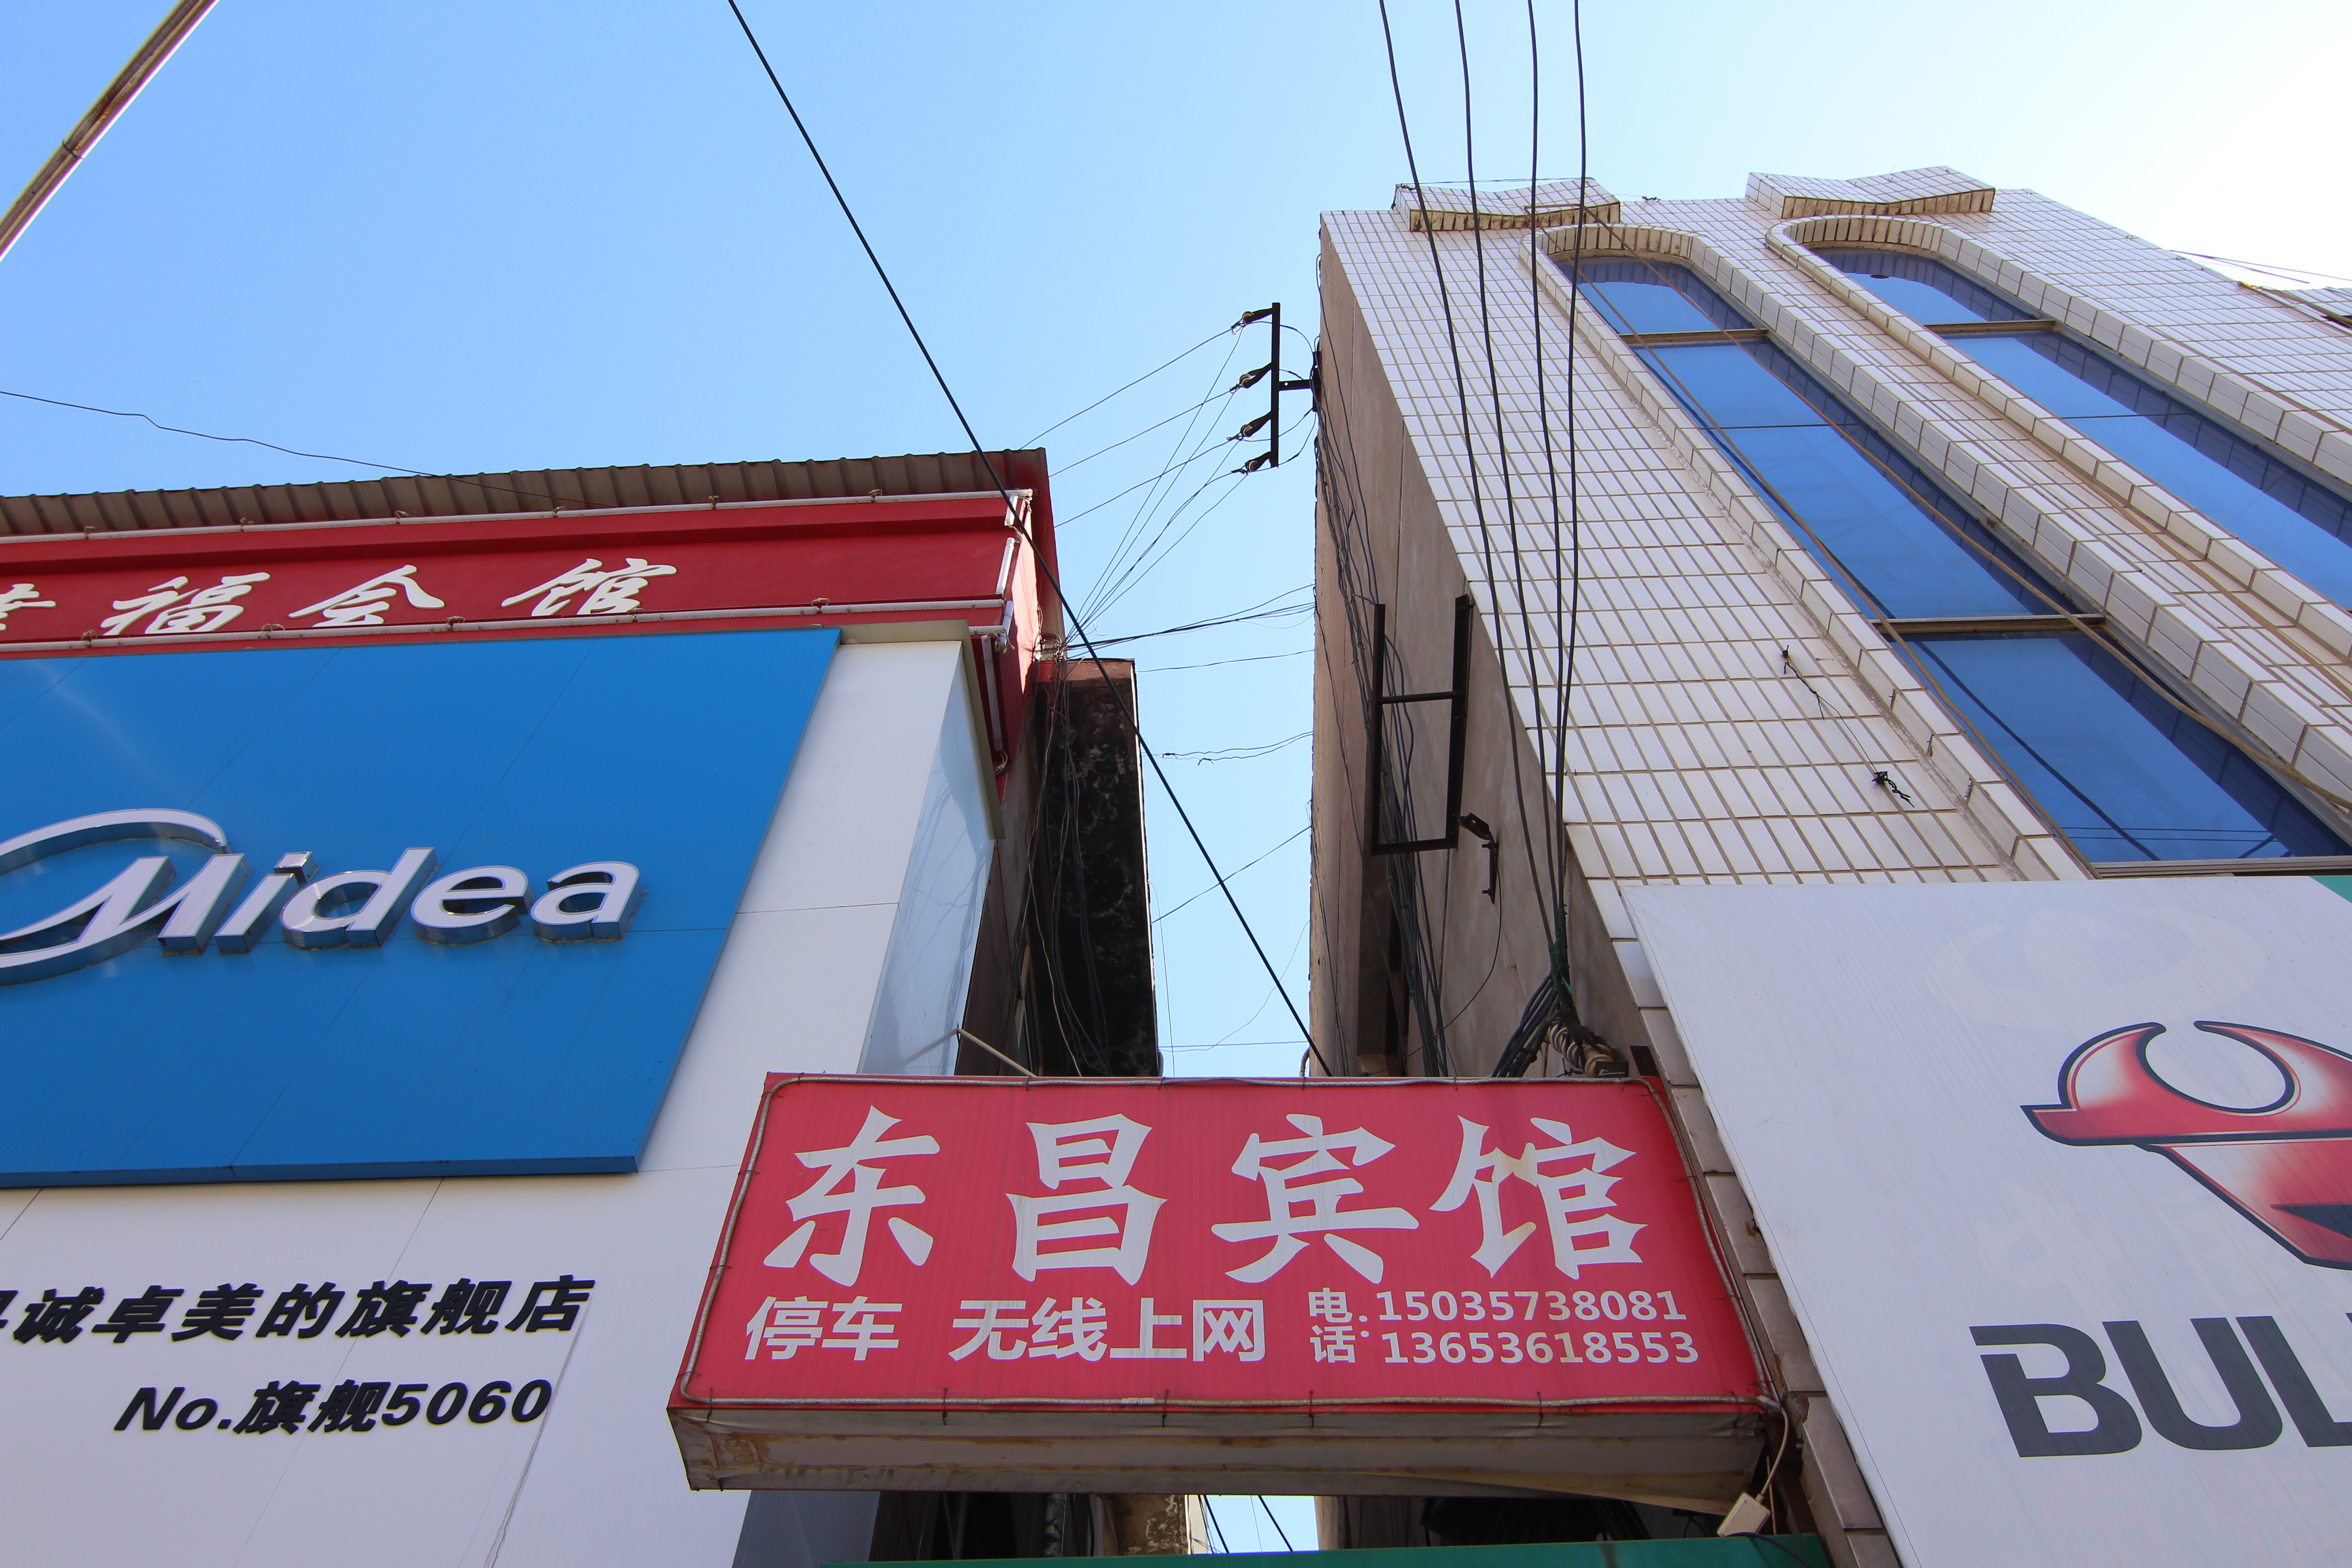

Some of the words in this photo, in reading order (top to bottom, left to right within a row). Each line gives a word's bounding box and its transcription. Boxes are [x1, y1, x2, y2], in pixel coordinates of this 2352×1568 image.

[0, 808, 641, 980] Midea
[764, 1105, 1650, 1287] 东昌宾馆
[0, 1274, 595, 1343] 诚卓美的旗舰店
[745, 1295, 903, 1361] 停车
[948, 1297, 1266, 1362] 无线上网
[1376, 1290, 1687, 1321] 15035738081
[1381, 1331, 1699, 1364] 13653618553
[1969, 1311, 2352, 1458] BUL
